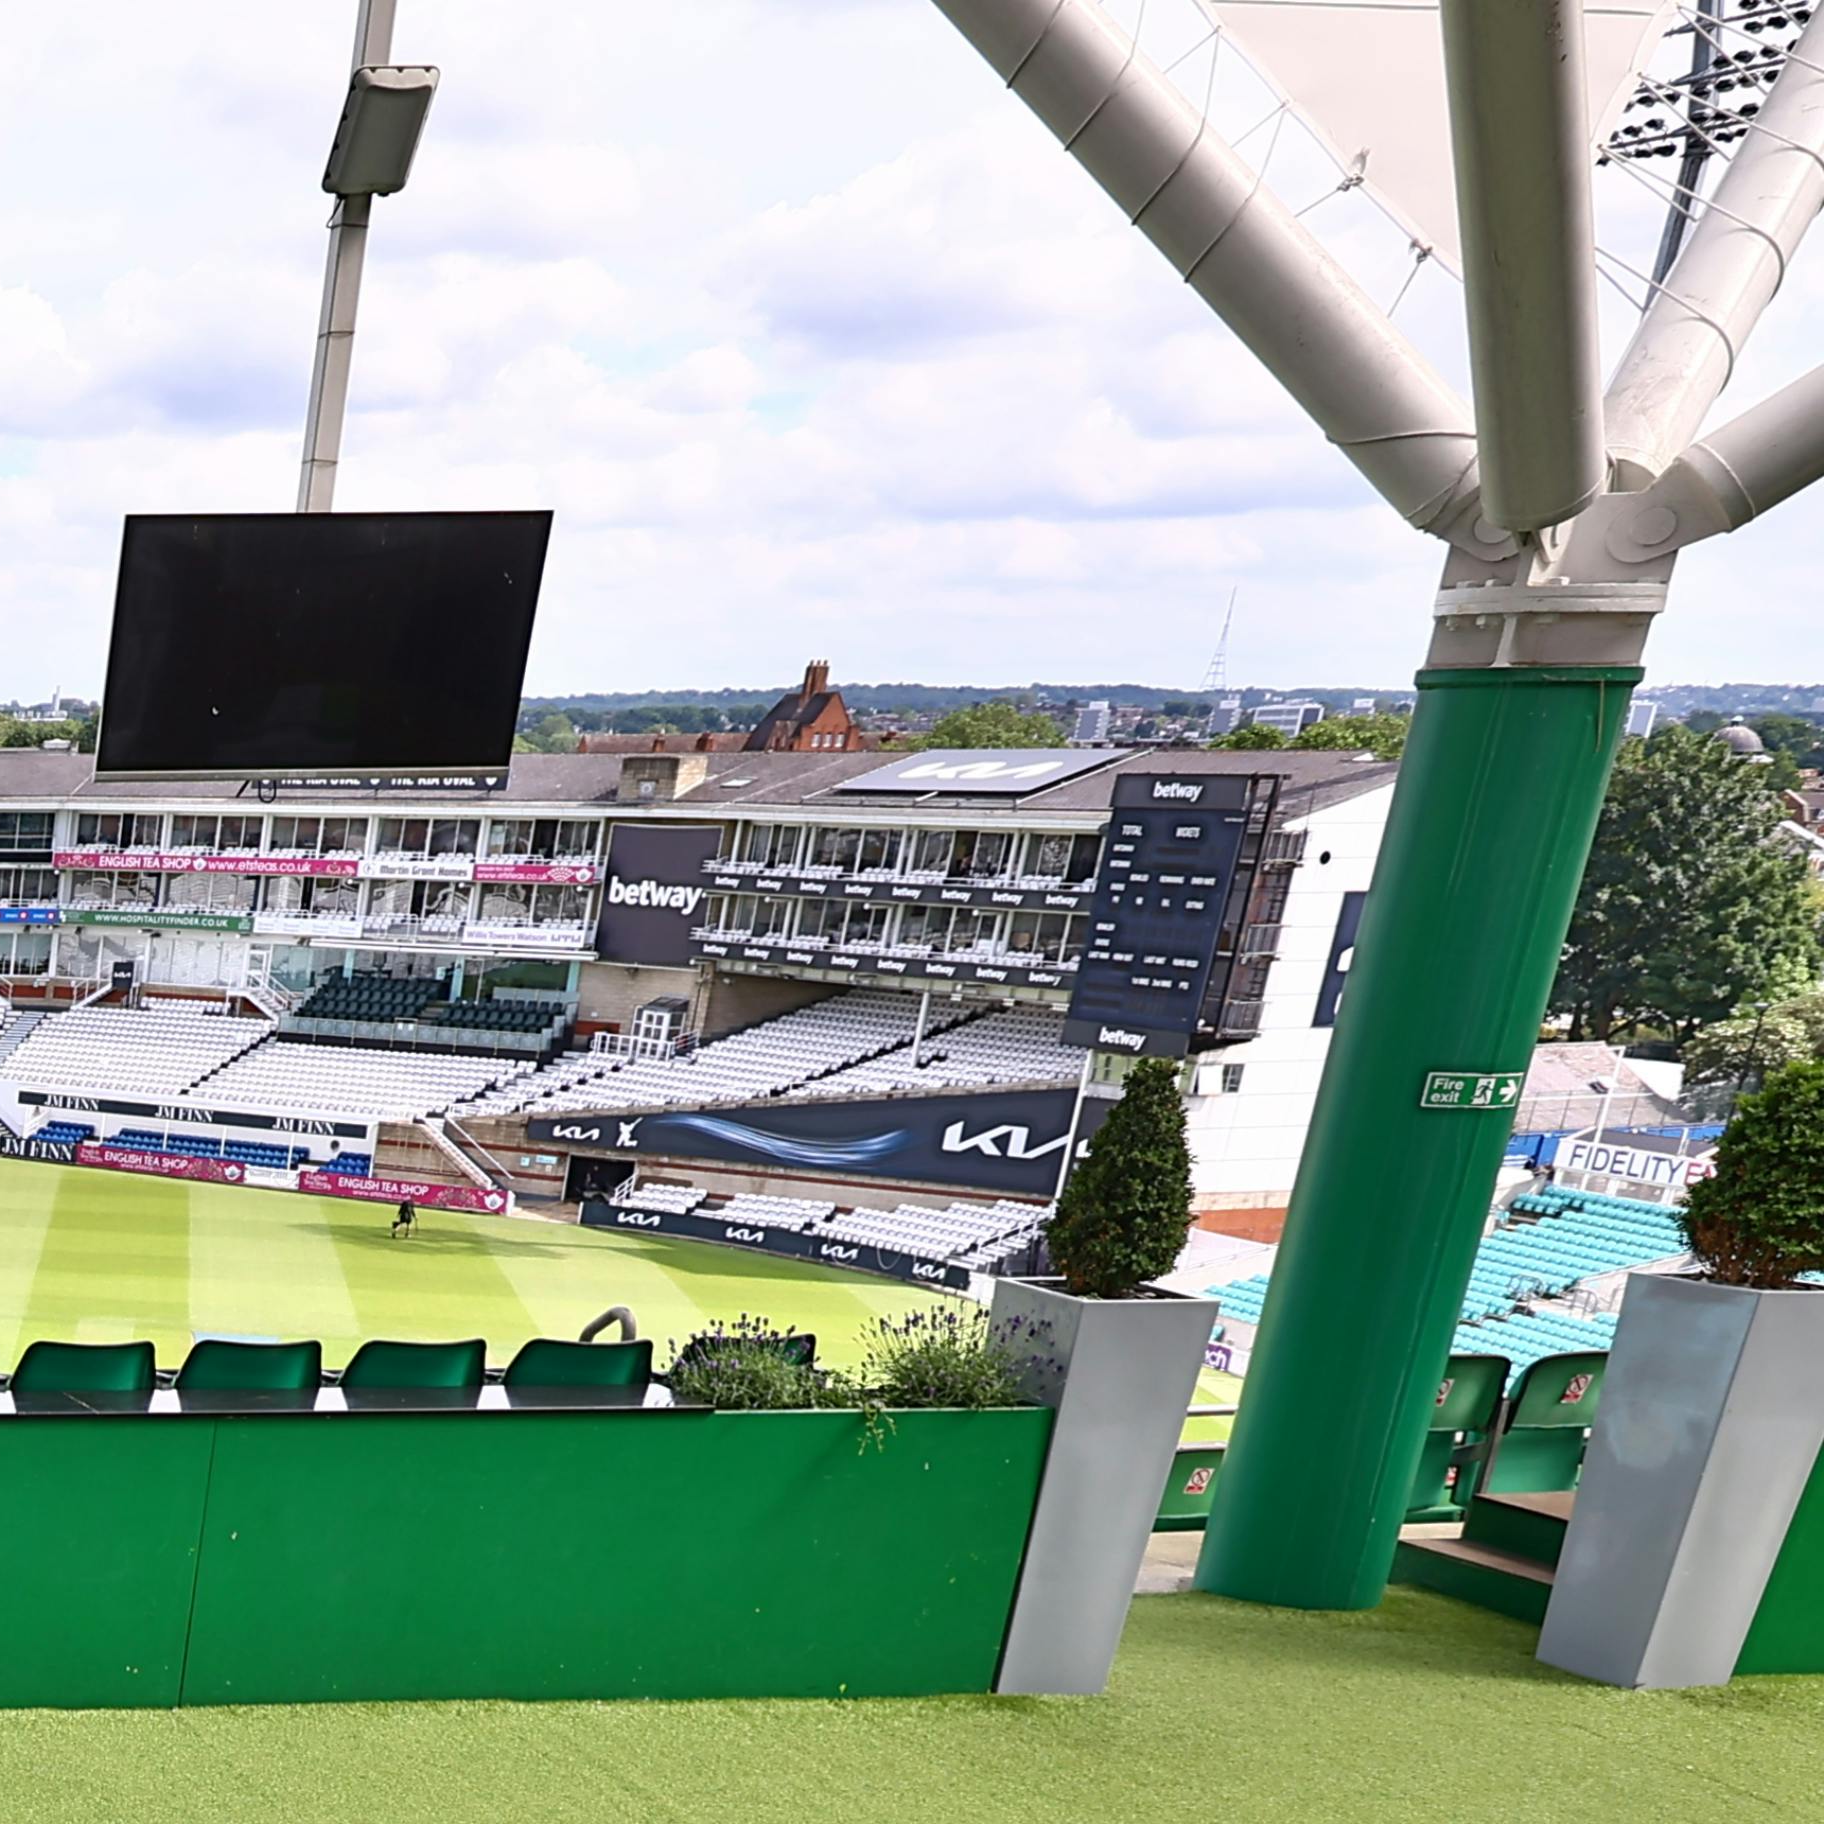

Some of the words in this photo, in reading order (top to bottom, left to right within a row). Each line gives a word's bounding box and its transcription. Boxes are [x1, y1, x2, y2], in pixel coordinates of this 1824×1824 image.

[1153, 781, 1203, 802] betway
[99, 856, 141, 869] ENGLISH
[142, 857, 160, 869] TEA
[162, 858, 192, 870] SHOP
[438, 867, 467, 877] Homes
[715, 876, 740, 888] betway
[756, 879, 783, 891] betway
[800, 881, 826, 893] betway
[608, 876, 702, 915] betway
[844, 884, 873, 896] betway
[892, 887, 922, 899] betway
[941, 889, 972, 902] betway
[992, 892, 1024, 905] betway
[1046, 894, 1079, 907] betway
[703, 944, 728, 956] betway
[744, 947, 770, 959] betway
[787, 951, 813, 963] betway
[831, 955, 859, 968] betway
[877, 959, 907, 972] betway
[926, 963, 956, 976] betway
[976, 967, 1008, 981] betway
[1029, 972, 1061, 986] betway
[1099, 1026, 1146, 1051] betway
[1433, 1077, 1464, 1090] Fire
[70, 1096, 100, 1111] FINN
[1430, 1092, 1460, 1103] exit
[155, 1105, 178, 1118] JM
[181, 1107, 214, 1122] FINN
[273, 1118, 294, 1131] JM
[297, 1120, 335, 1136] FINN
[2, 1136, 27, 1157] JM
[30, 1140, 74, 1161] FINN
[104, 1151, 142, 1165] ENGLISH
[144, 1154, 160, 1167] TEA
[161, 1157, 188, 1170] SHOP
[1569, 1144, 1684, 1184] FIDELITY
[338, 1177, 380, 1190] ENGLISH
[382, 1180, 398, 1193] TEA
[400, 1183, 429, 1196] SHOP
